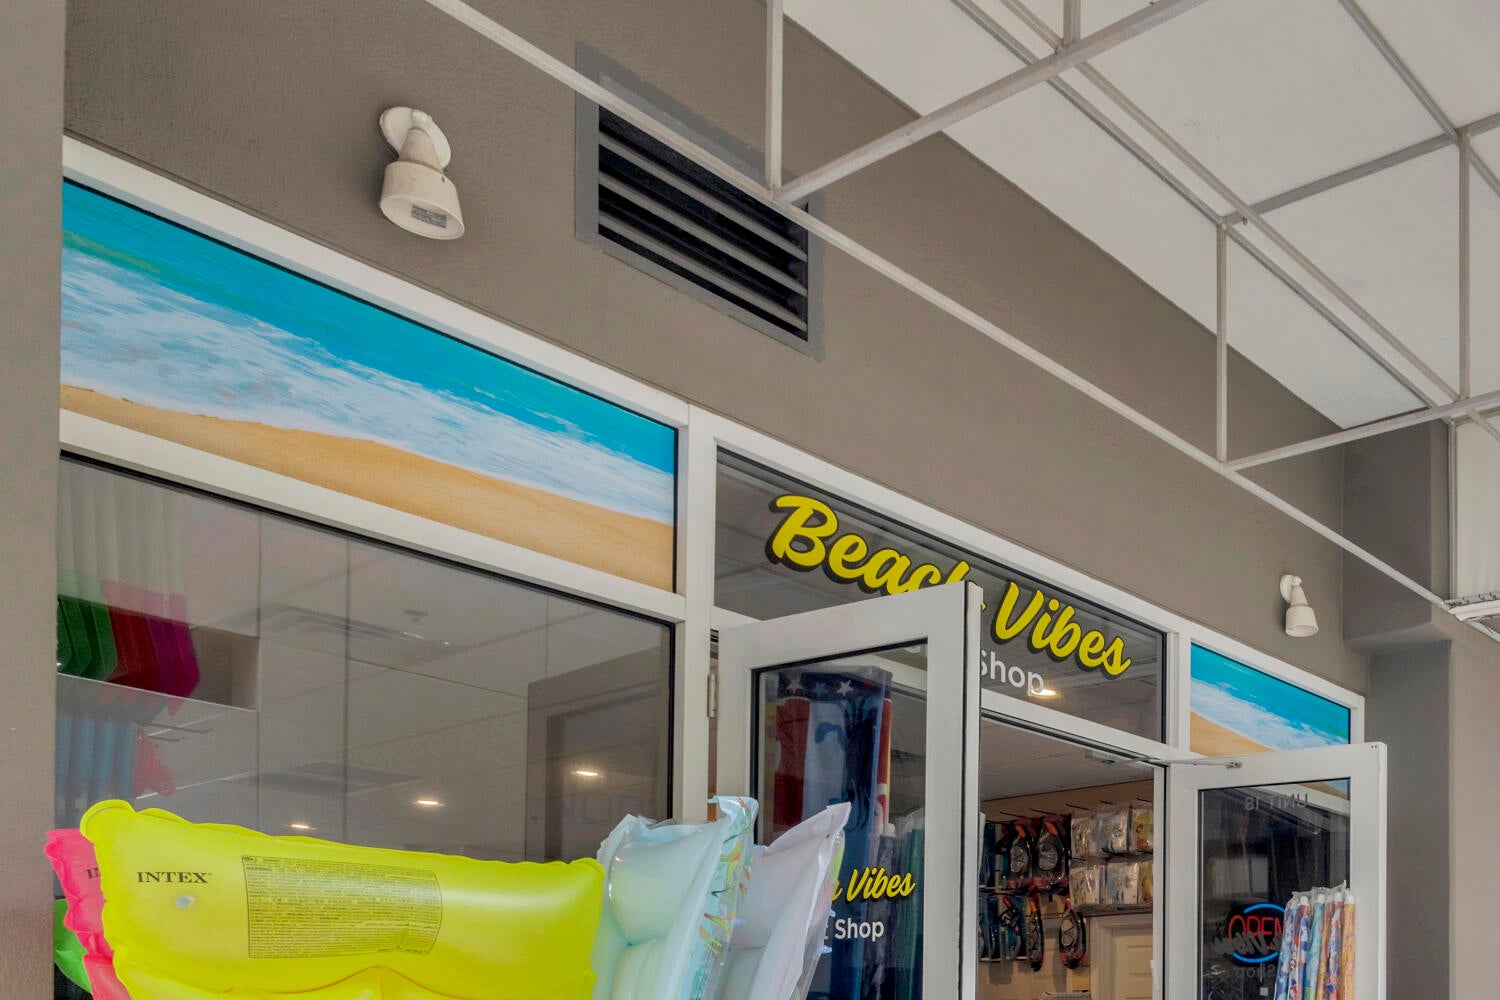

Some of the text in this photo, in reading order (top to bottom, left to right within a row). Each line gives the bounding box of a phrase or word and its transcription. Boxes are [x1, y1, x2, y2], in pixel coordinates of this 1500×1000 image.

[766, 495, 1132, 679] Beac Vibes
[137, 871, 209, 884] INTEX
[846, 867, 916, 902] Vibes
[834, 918, 885, 941] Shop
